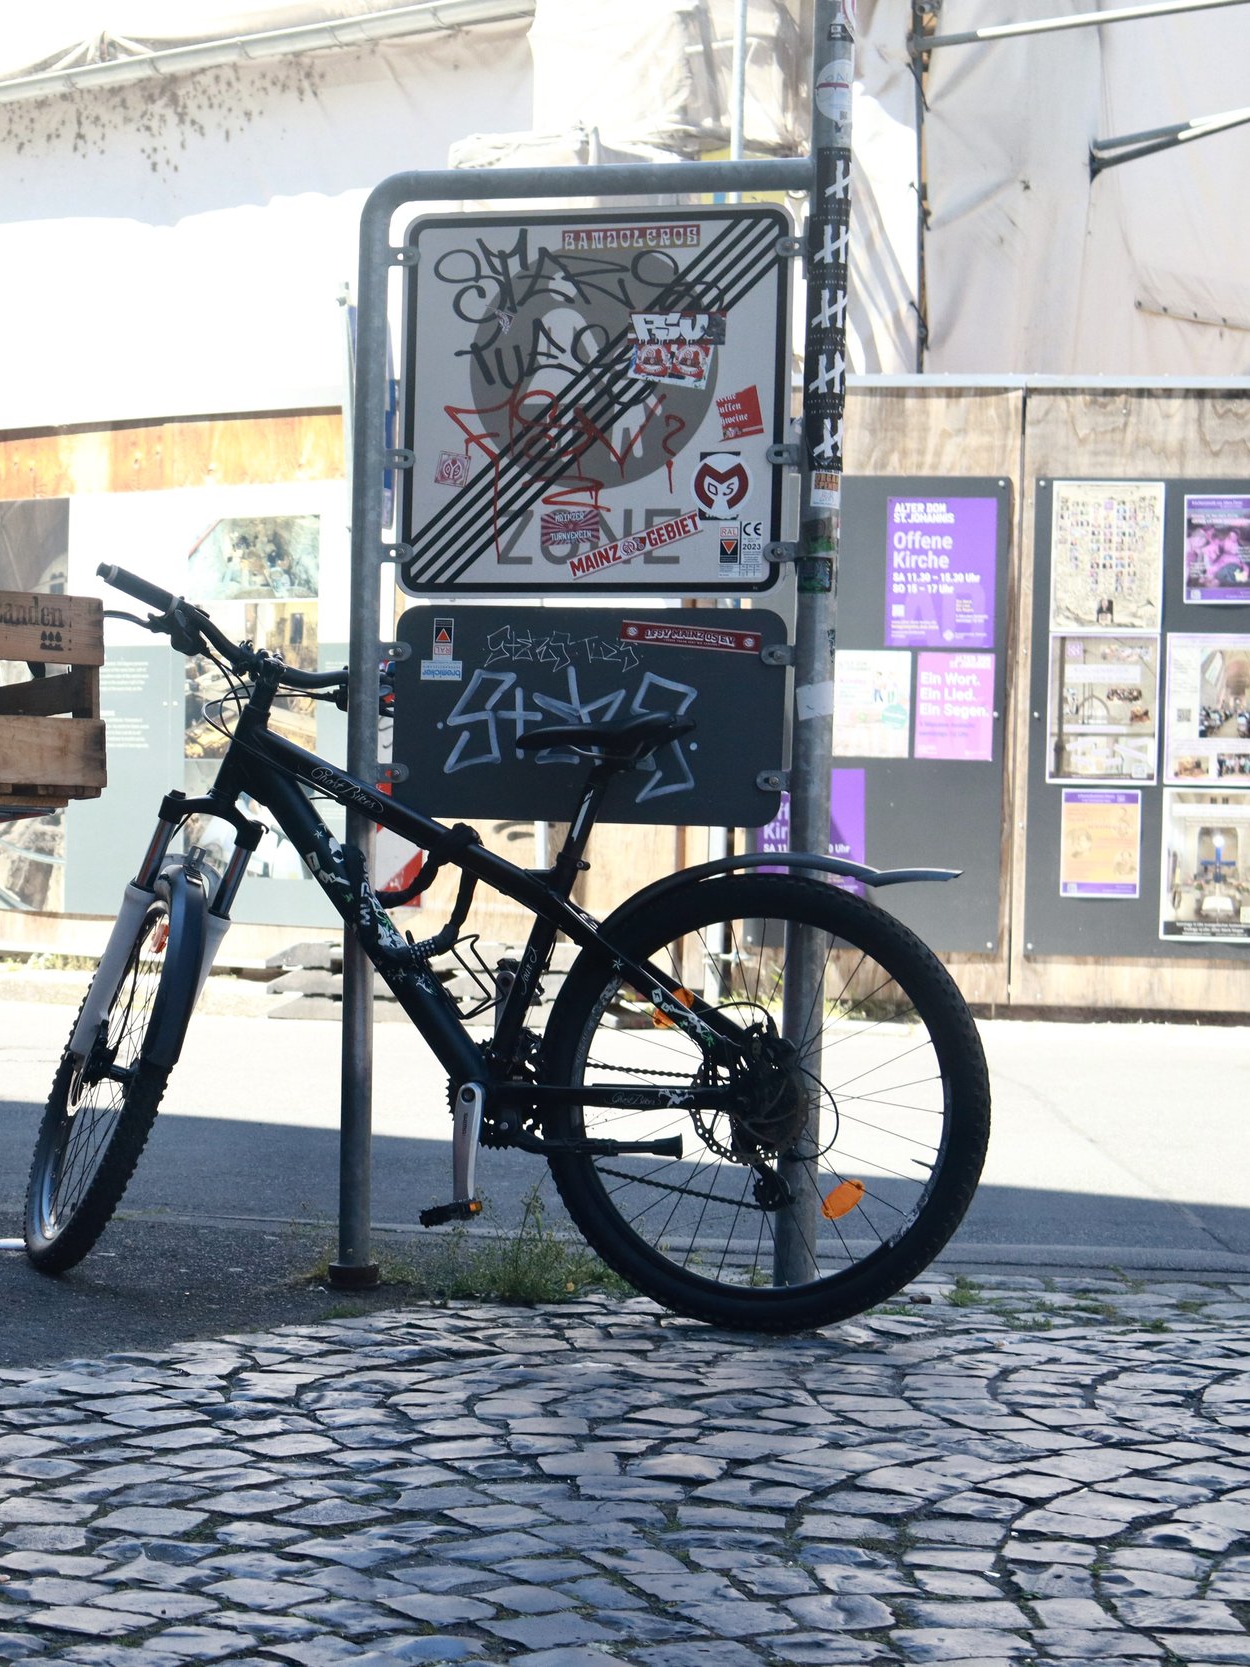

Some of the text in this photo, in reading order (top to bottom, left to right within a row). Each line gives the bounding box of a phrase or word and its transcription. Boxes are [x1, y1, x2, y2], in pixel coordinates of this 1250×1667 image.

[894, 502, 947, 513] ALTER DOM
[721, 528, 736, 536] RAL
[569, 513, 698, 577] MAINZ GEBIET
[893, 530, 953, 549] Offene
[743, 543, 761, 551] 2023
[893, 550, 950, 569] Kirche
[892, 572, 906, 582] SA
[965, 572, 981, 583] Uhr
[892, 583, 906, 593] SO
[927, 583, 937, 593] 17
[938, 583, 954, 593] Uhr
[671, 629, 704, 640] MAINZ
[920, 672, 981, 686] Ein Wort.
[920, 687, 976, 701] Ein Lied.
[919, 703, 989, 718] Ein Segen.
[763, 822, 789, 840] Kir
[763, 843, 775, 852] SA
[835, 844, 850, 853] Uhr
